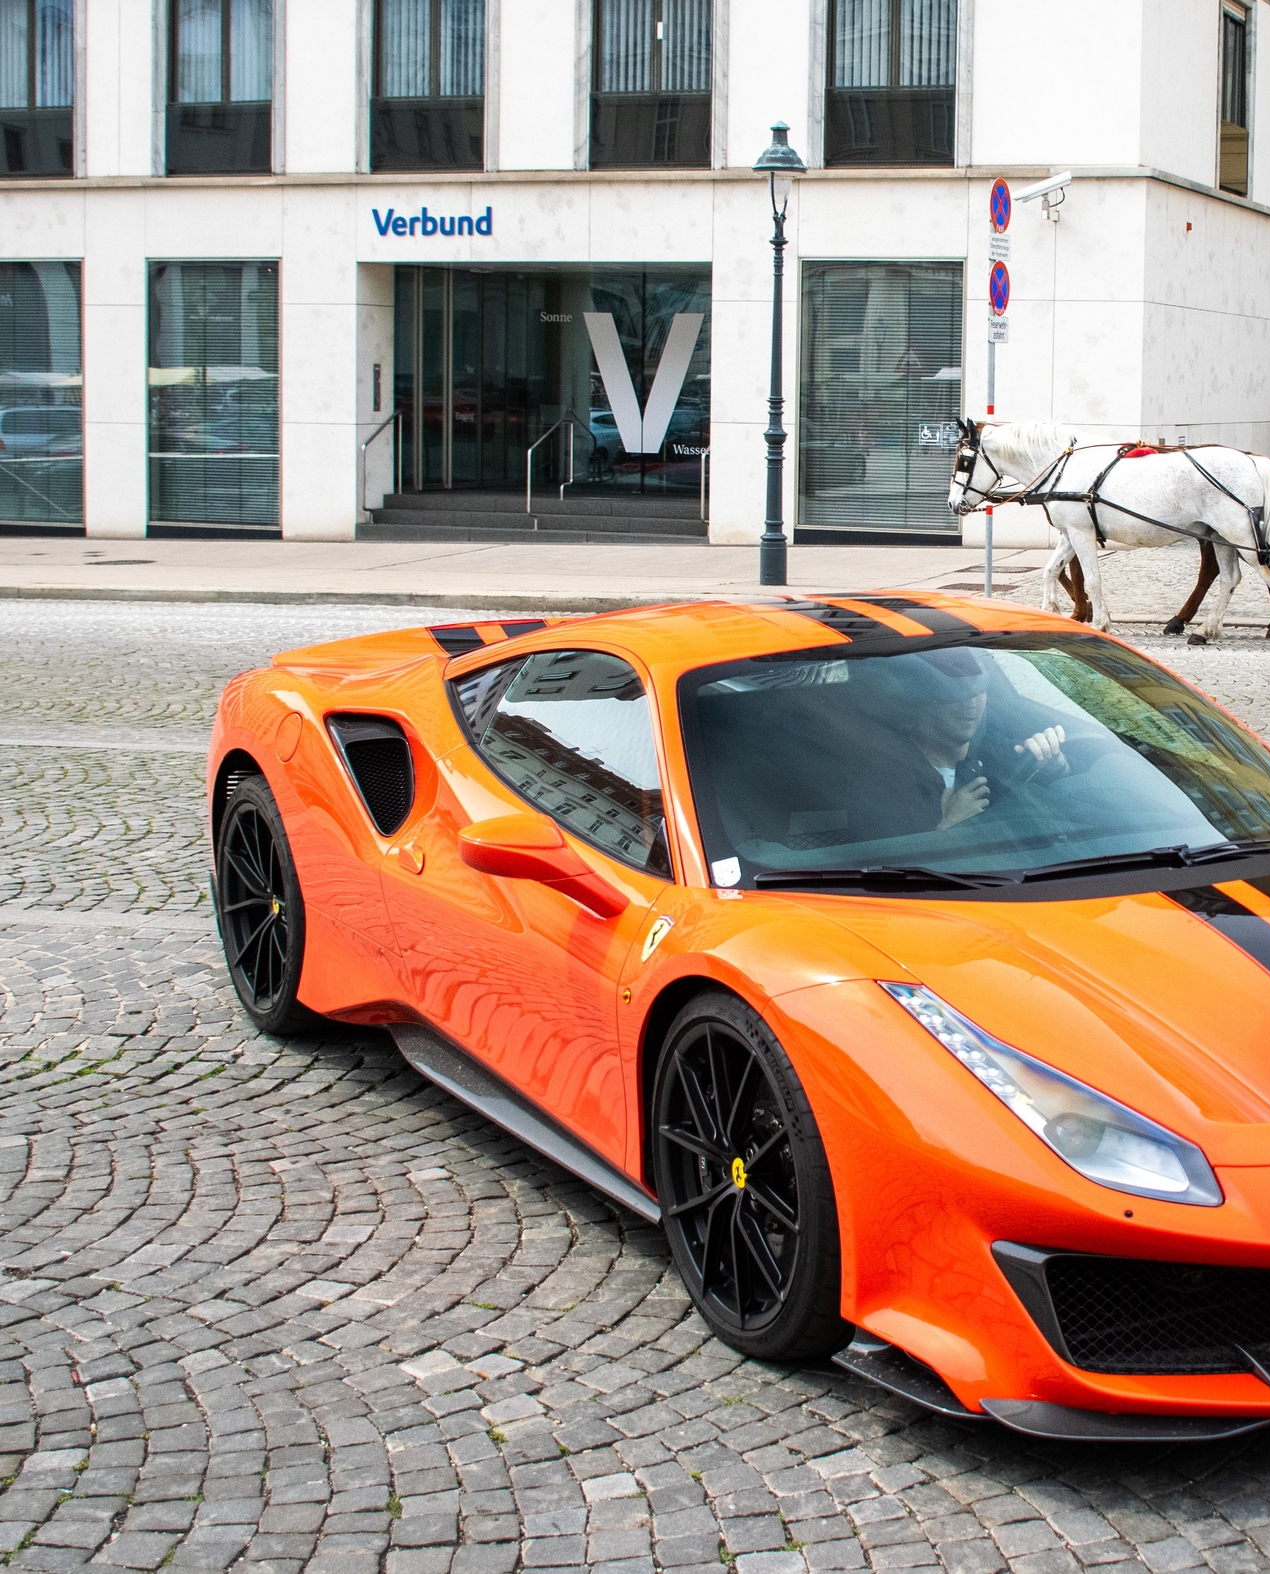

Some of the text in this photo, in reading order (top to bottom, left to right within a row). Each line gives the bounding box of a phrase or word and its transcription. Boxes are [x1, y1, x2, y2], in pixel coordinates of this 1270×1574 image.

[371, 206, 493, 236] Verbund
[540, 311, 573, 322] Sonne
[583, 312, 705, 454] V
[764, 1050, 795, 1112] MICHELIN
